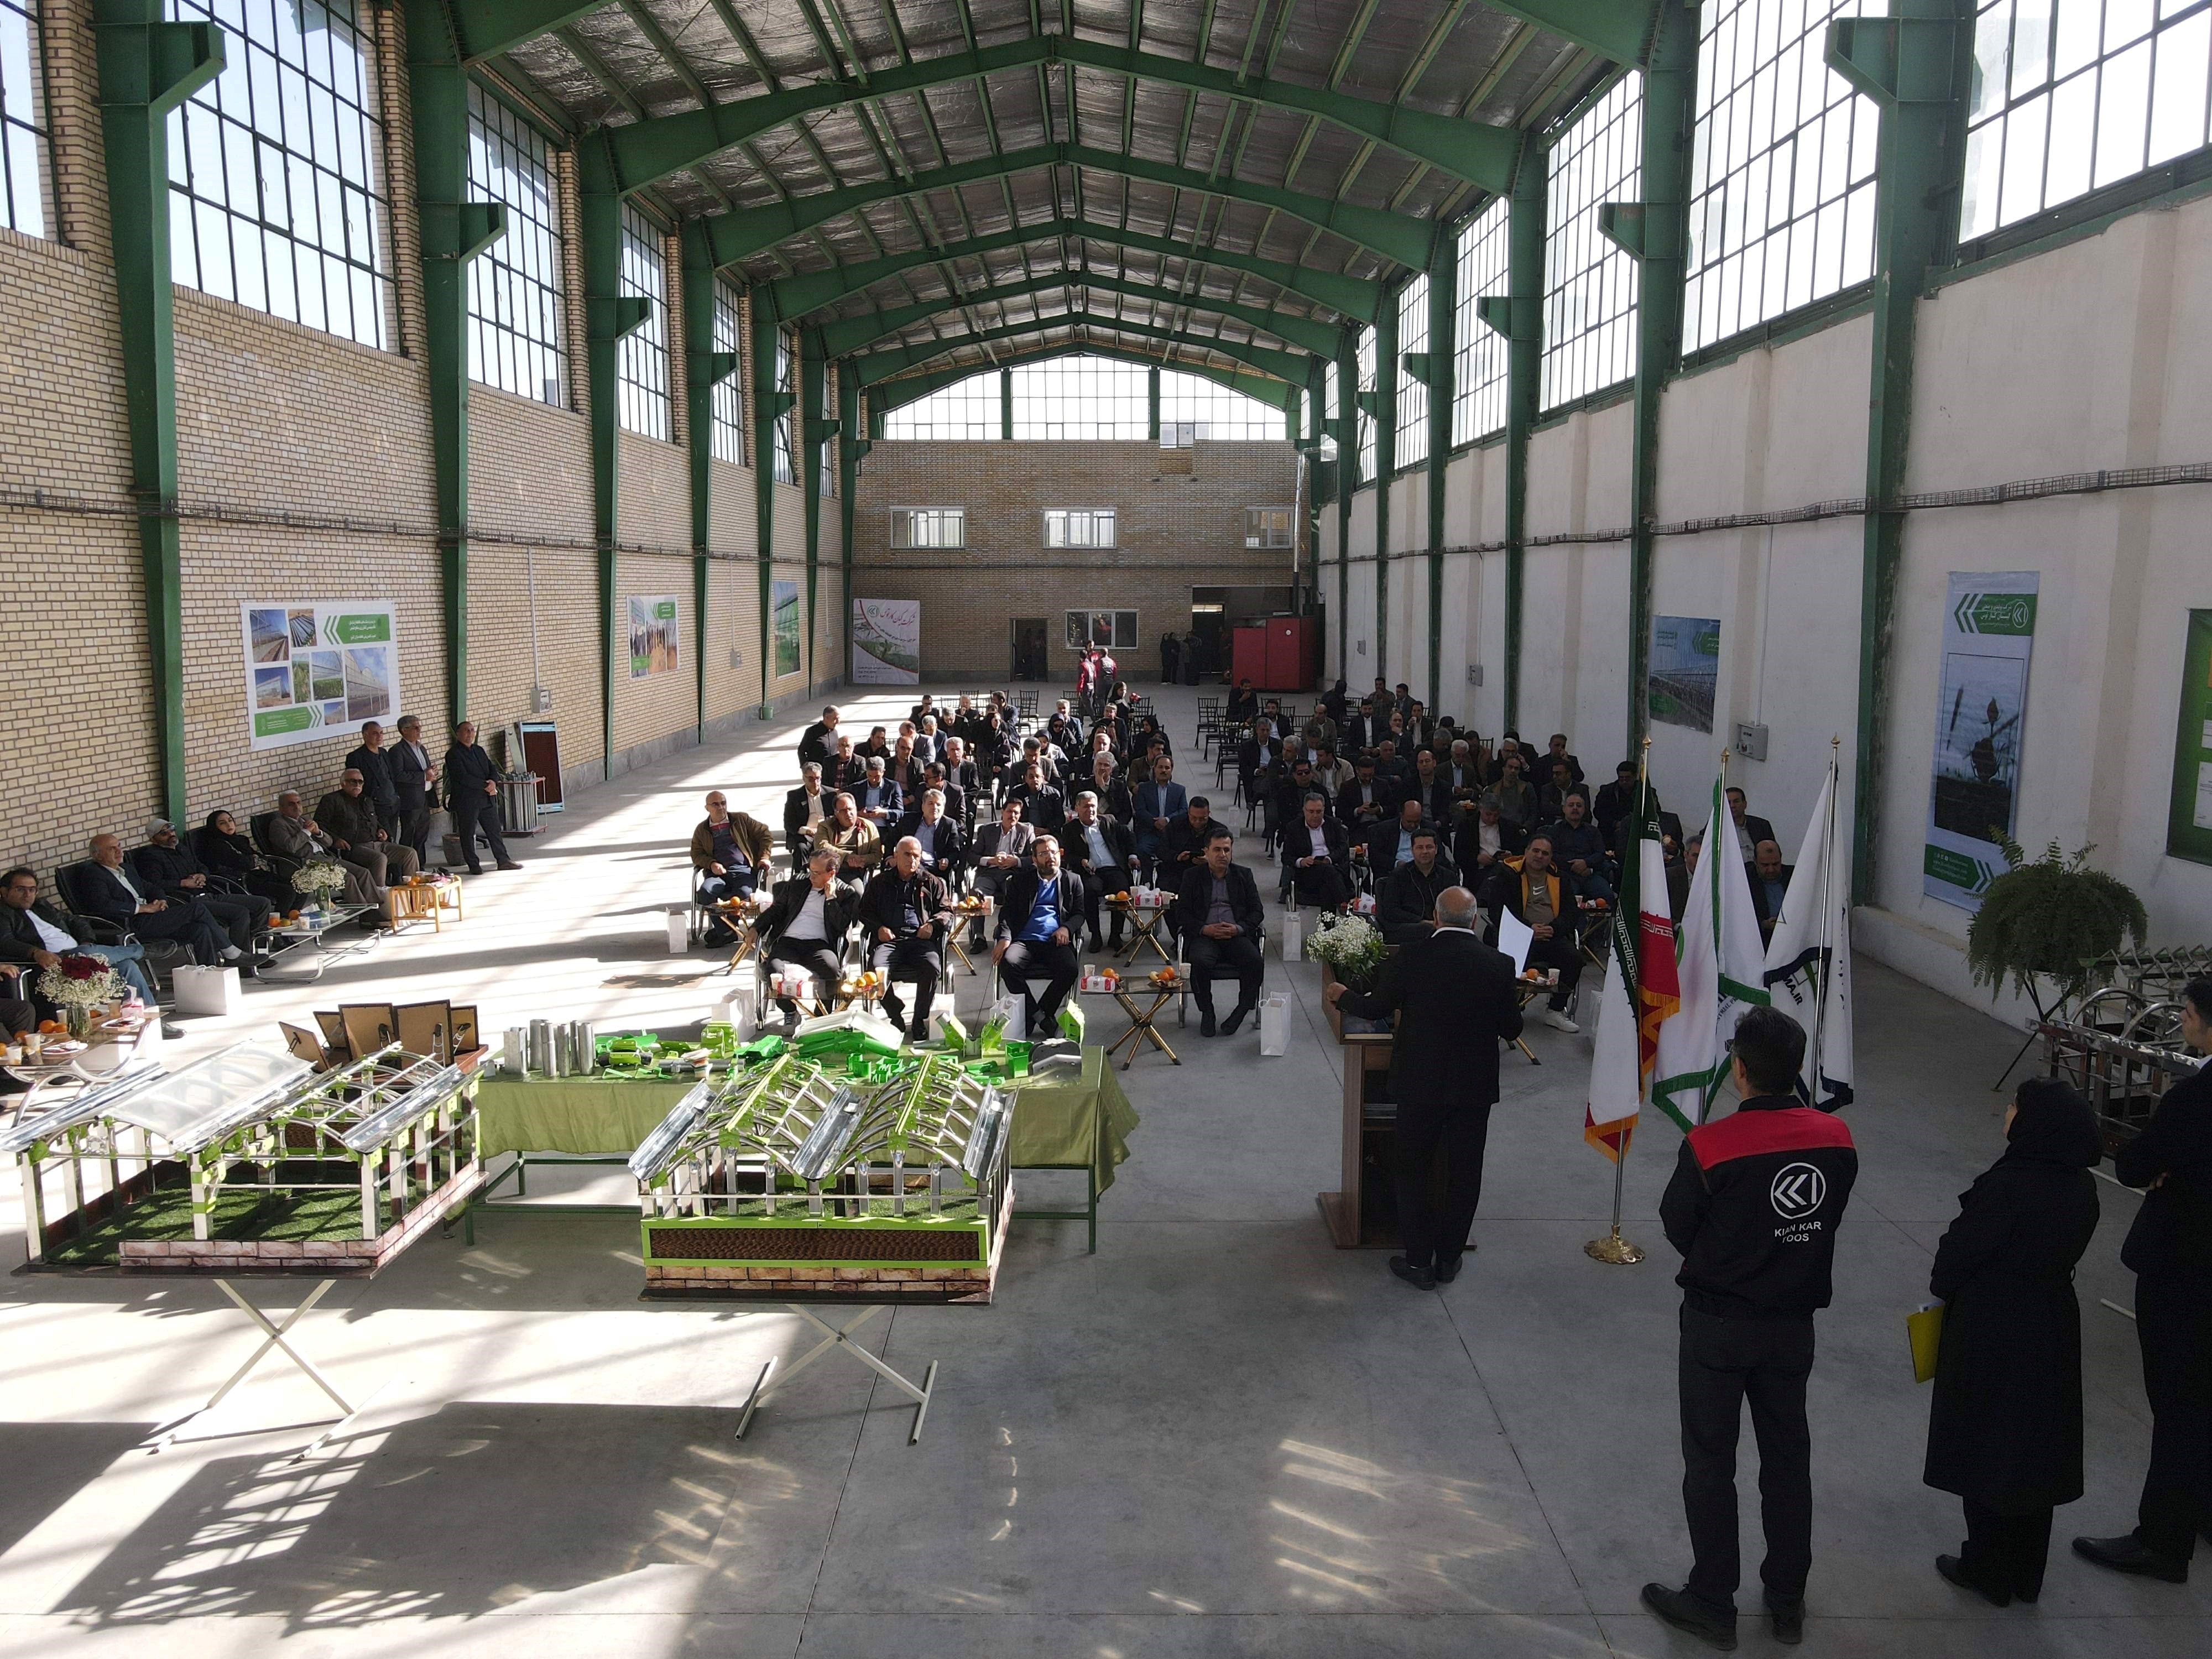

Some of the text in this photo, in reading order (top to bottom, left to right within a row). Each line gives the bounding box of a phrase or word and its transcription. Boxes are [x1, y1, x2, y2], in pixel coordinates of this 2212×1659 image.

[1717, 1003, 1732, 1022] STRIAL
[1775, 1221, 1822, 1237] KIAN KAR
[1782, 1233, 1809, 1243] TOOS
